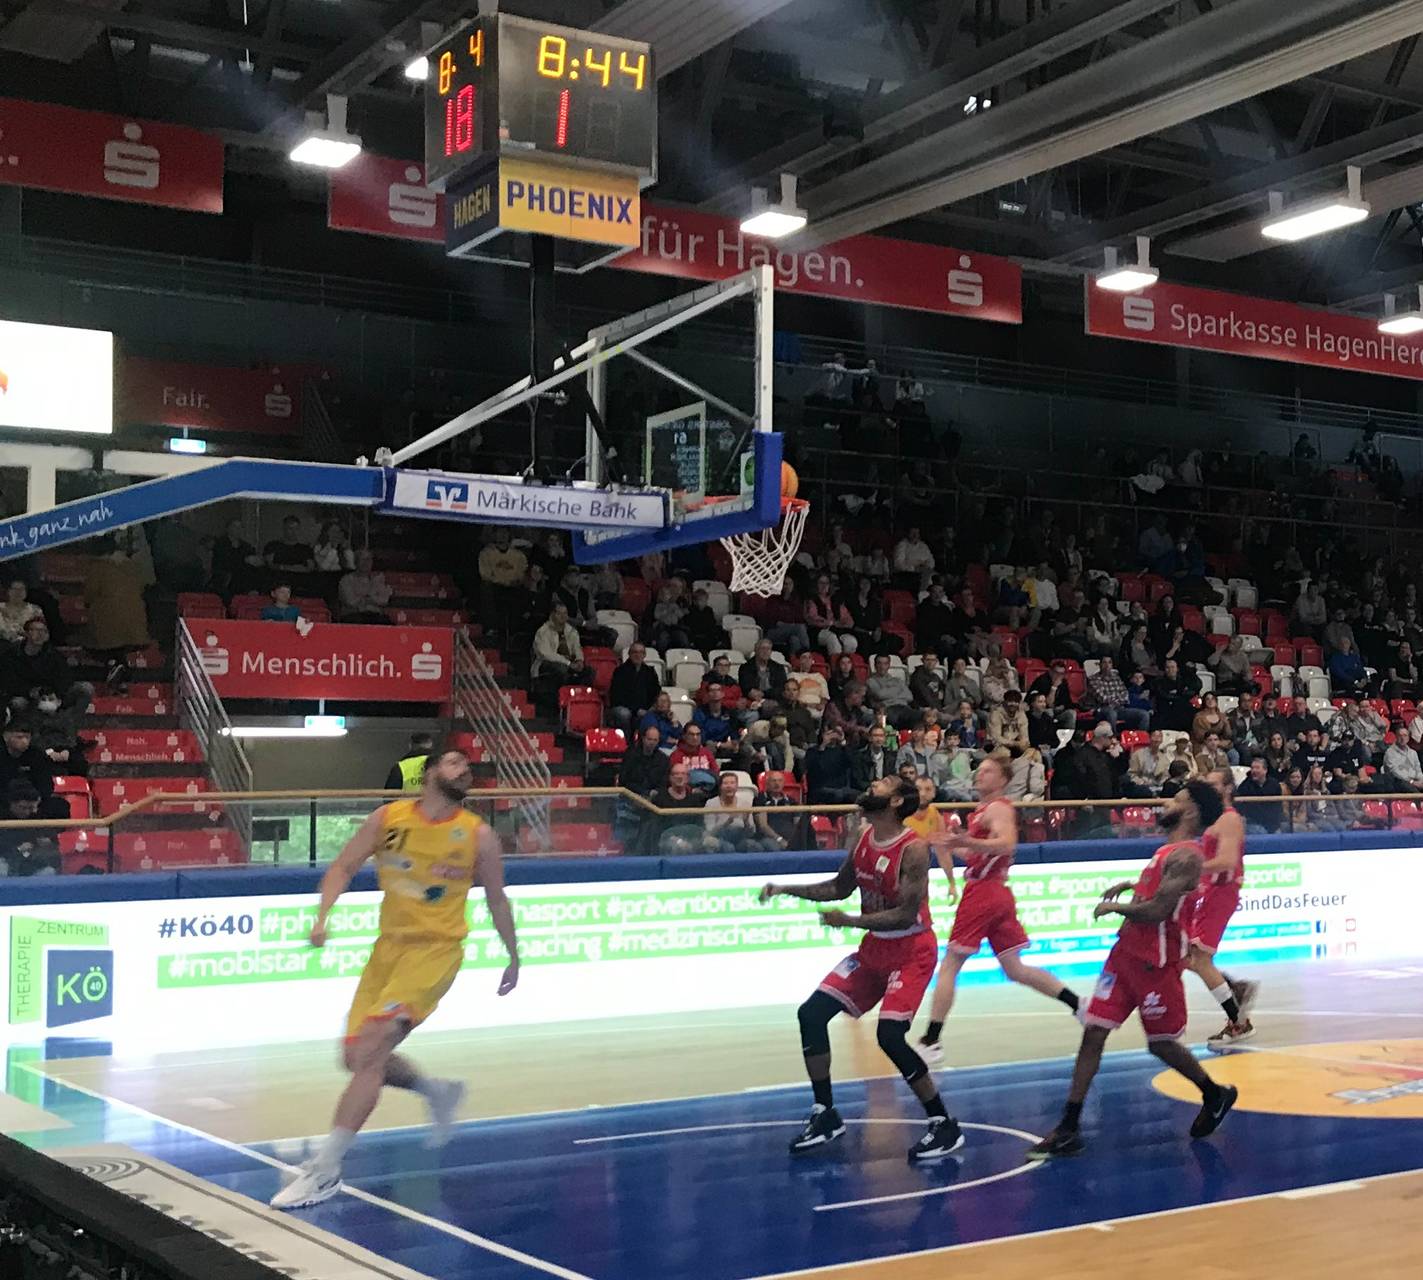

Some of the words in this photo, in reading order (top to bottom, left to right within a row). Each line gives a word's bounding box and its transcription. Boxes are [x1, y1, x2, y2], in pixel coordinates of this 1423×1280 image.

[538, 35, 646, 91] 8:44
[444, 83, 474, 157] 18
[555, 88, 570, 149] 1
[453, 183, 491, 230] HAGEN
[506, 179, 633, 225] PHOENIX
[641, 215, 704, 263] für
[717, 228, 865, 288] Hagen.
[1170, 303, 1298, 348] Sparkasse
[477, 489, 583, 516] Märkische
[589, 502, 637, 521] Bank
[241, 650, 403, 679] Menschlich.
[1235, 892, 1348, 912] SindDasFeuer
[37, 920, 105, 937] ZENTRUM
[157, 914, 254, 938] #Kö40
[16, 935, 33, 1017] THERAPIE
